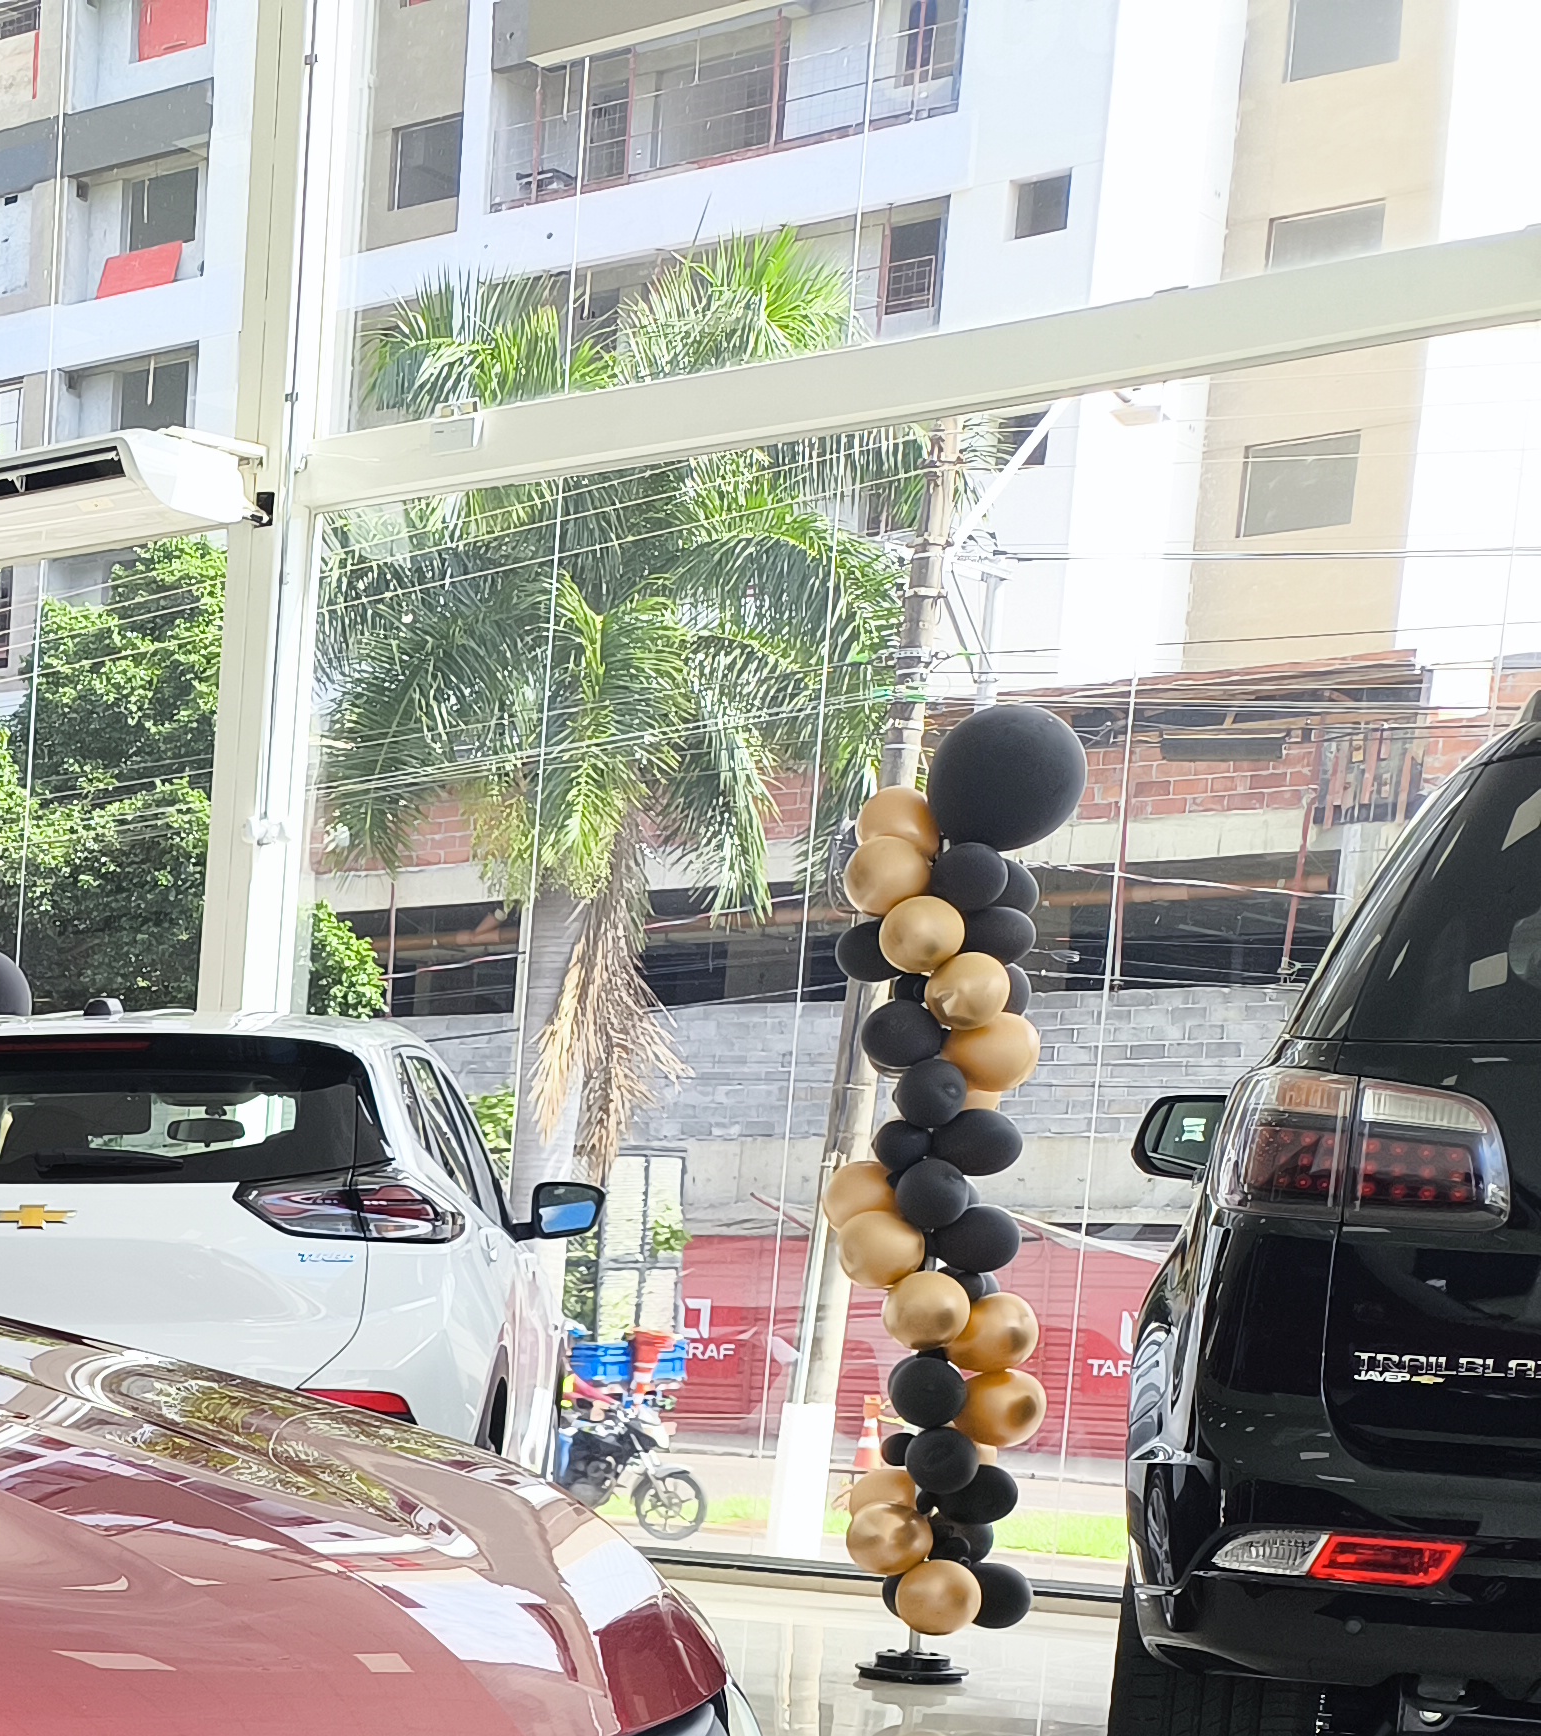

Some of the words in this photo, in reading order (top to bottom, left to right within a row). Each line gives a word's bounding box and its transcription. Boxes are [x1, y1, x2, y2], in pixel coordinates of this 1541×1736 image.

[686, 1343, 735, 1360] RAF
[1353, 1351, 1541, 1379] TRAILBLA
[1353, 1370, 1410, 1383] JAVEP
